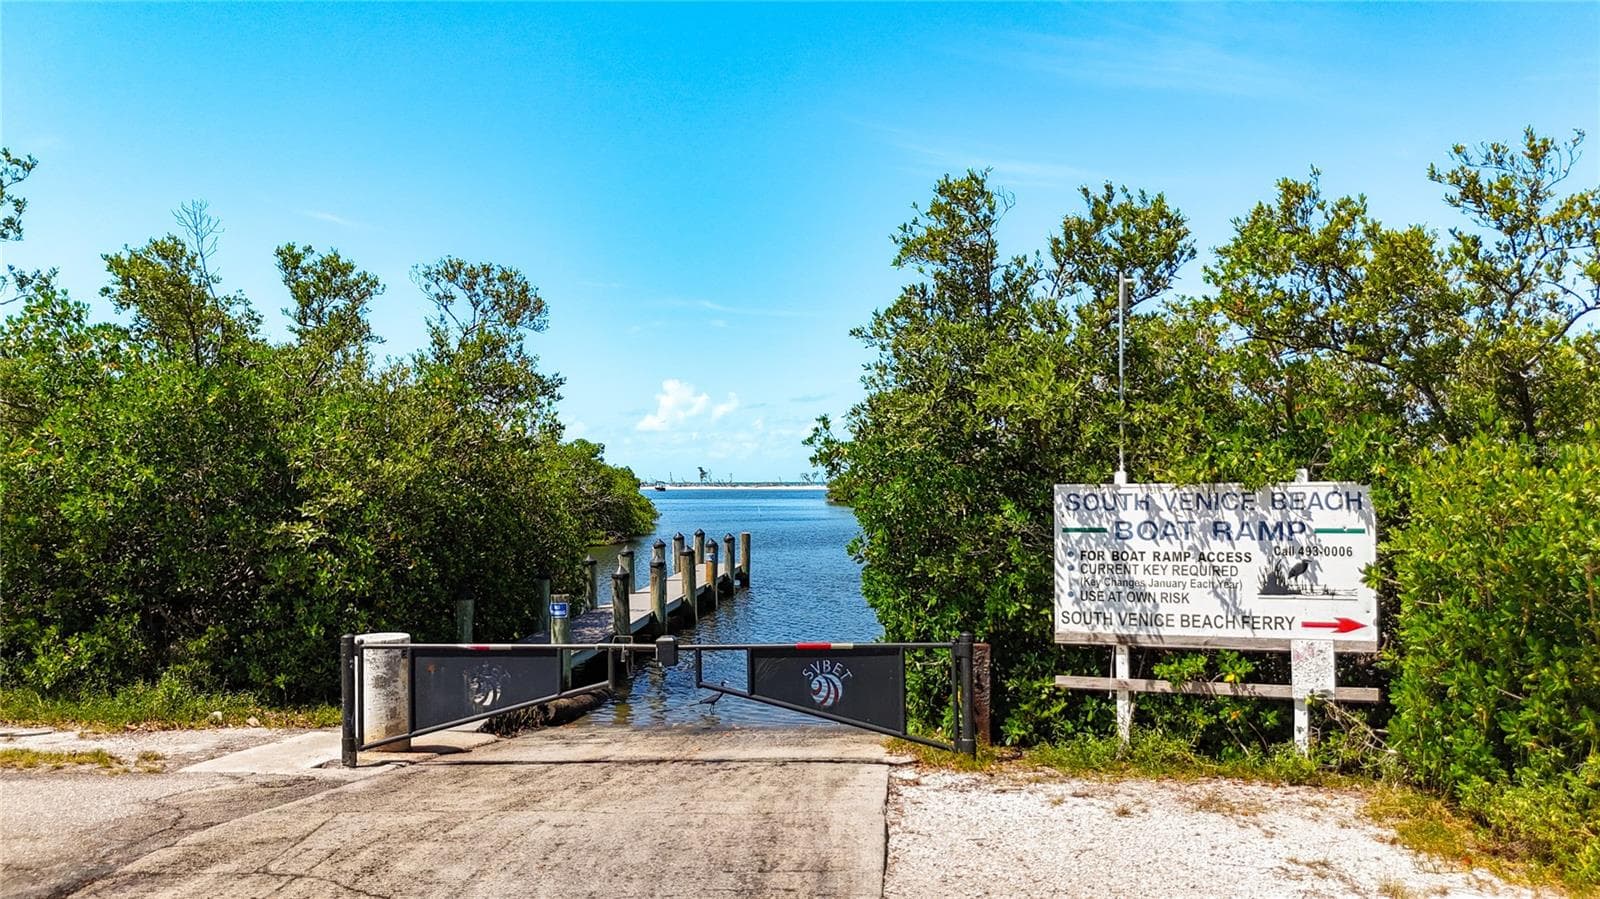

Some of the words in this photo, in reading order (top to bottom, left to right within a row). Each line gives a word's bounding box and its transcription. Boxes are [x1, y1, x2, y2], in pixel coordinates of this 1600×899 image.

[1065, 492, 1150, 511] SOUTH
[1164, 492, 1254, 511] VENICE
[1271, 491, 1362, 511] BEACH
[1114, 521, 1196, 540] BOAT
[1212, 521, 1306, 541] RAMP
[1080, 550, 1106, 562] FOR
[1111, 551, 1147, 562] BOAT
[1152, 551, 1192, 563] RAMP
[1198, 551, 1252, 563] ACCESS
[1274, 546, 1295, 556] Call
[1299, 547, 1352, 557] 493-0006
[1080, 563, 1139, 576] CURRENT
[1143, 565, 1169, 576] KEY
[1172, 565, 1239, 577] REQUIRED
[1080, 577, 1101, 588] (Key
[1103, 578, 1146, 589] Changes
[1148, 578, 1187, 589] January
[1190, 579, 1214, 589] Each
[1217, 579, 1243, 590] Year)
[1080, 591, 1105, 602] USE
[1107, 591, 1124, 602] AT
[1126, 592, 1157, 603] OWN
[1160, 592, 1190, 604] RISK
[1061, 611, 1113, 626] SOUTH
[1117, 612, 1175, 628] VENICE
[1180, 614, 1236, 629] BEACH
[1241, 614, 1295, 630] FERRY
[802, 659, 853, 680] SVBET
